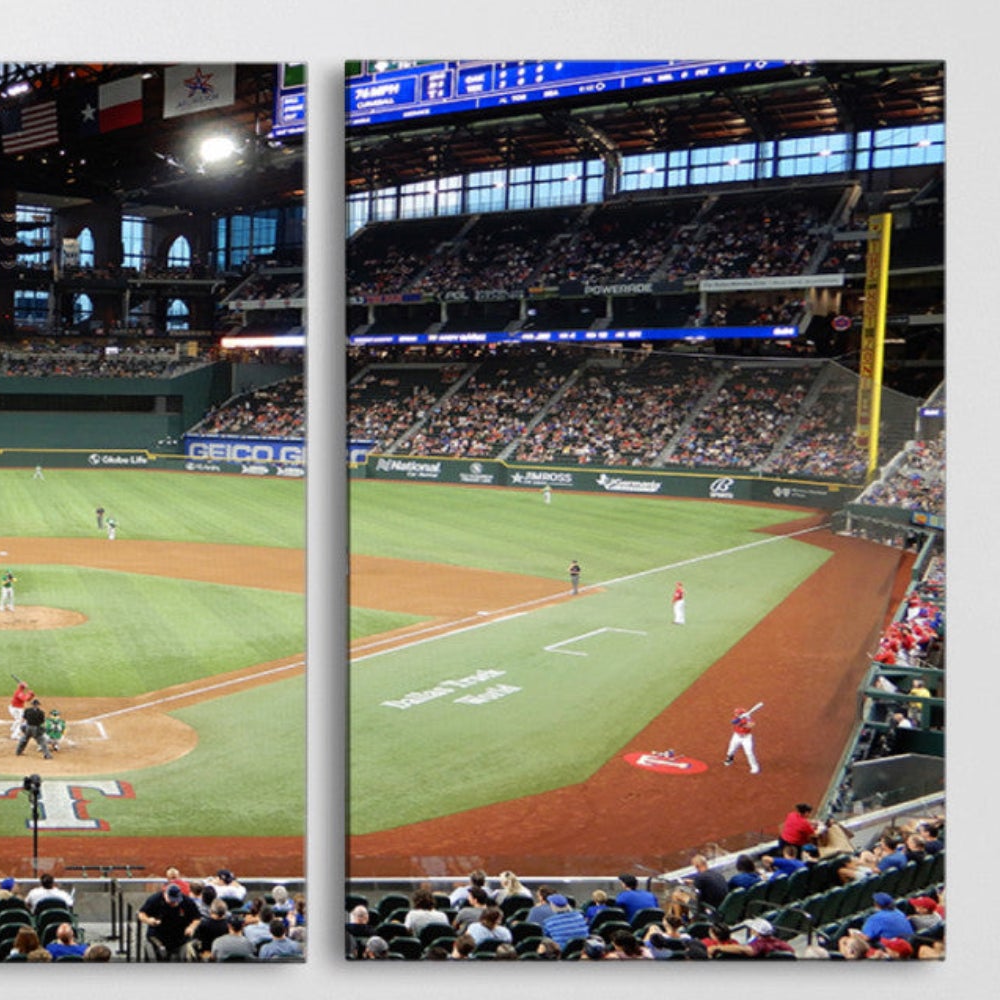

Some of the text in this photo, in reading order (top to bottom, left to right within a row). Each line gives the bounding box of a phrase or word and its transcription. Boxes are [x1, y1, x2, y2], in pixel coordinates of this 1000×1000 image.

[584, 282, 654, 295] POWERADE
[189, 442, 274, 462] GEICO
[130, 454, 148, 464] Life
[391, 459, 442, 473] National
